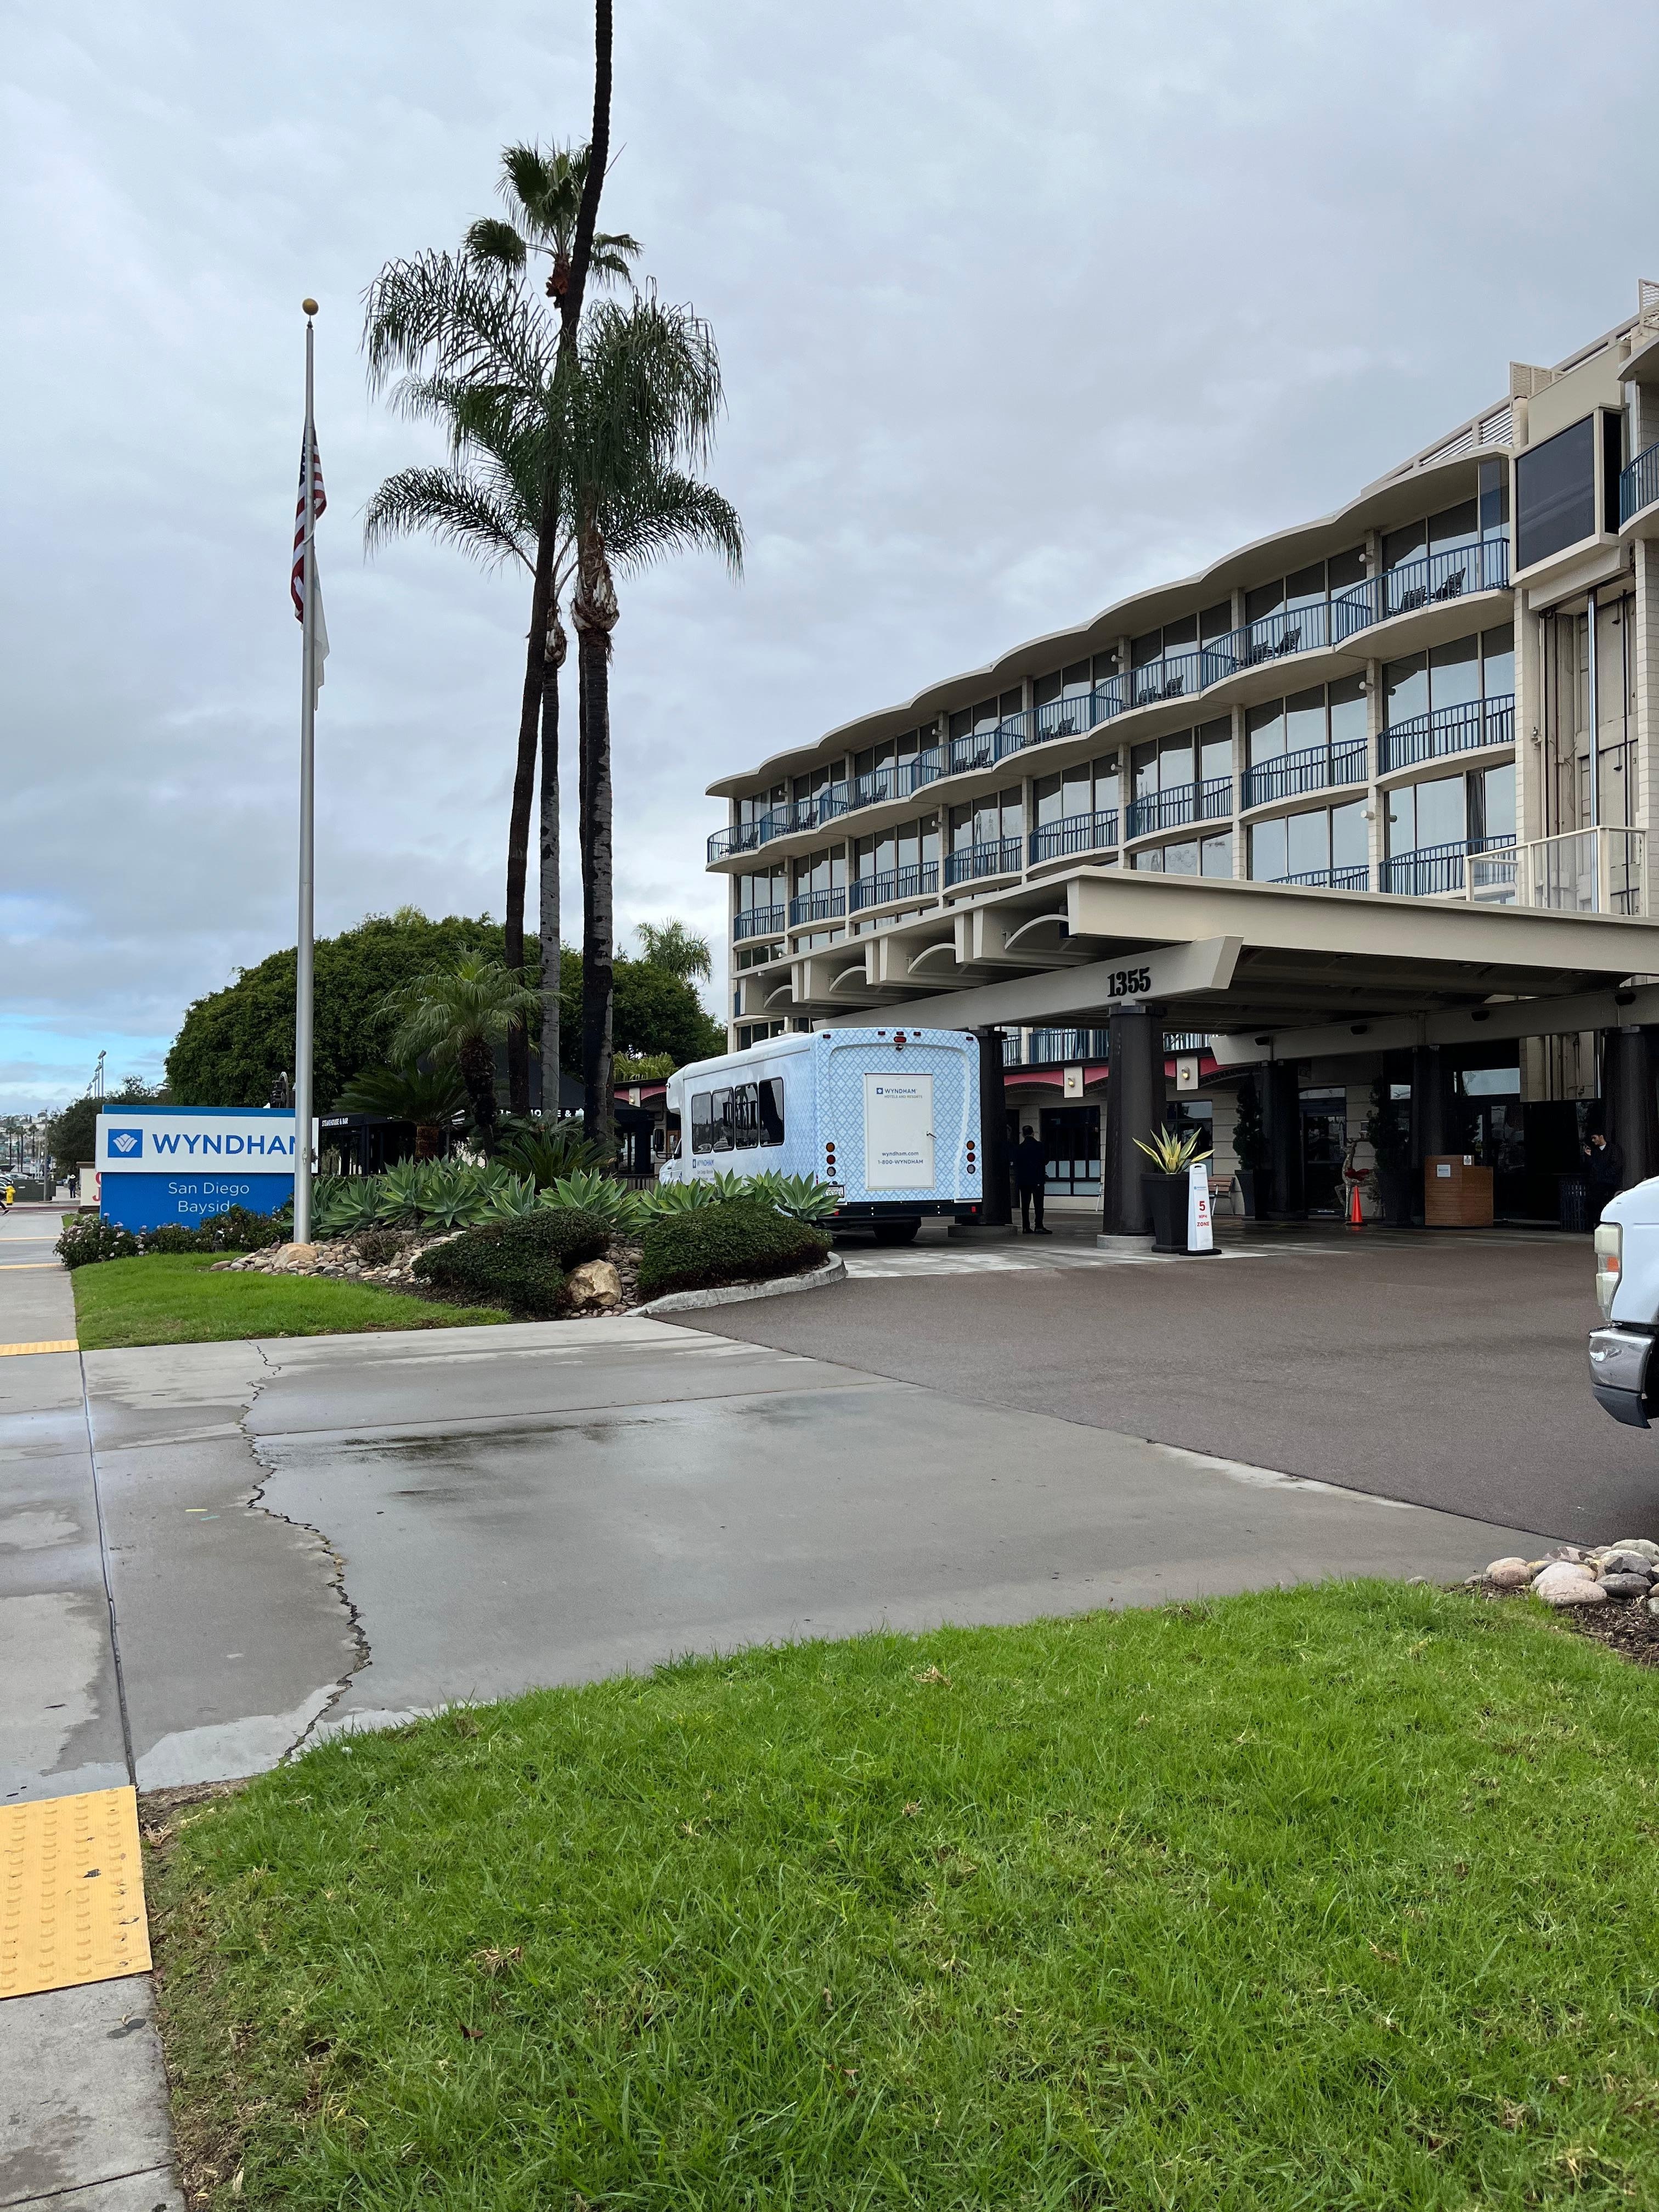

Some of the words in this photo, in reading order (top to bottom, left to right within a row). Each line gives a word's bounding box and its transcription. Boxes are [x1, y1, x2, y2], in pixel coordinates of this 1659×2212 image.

[1107, 967, 1151, 997] 1355
[168, 1182, 197, 1194] San
[204, 1182, 250, 1196] Diego
[1199, 1201, 1205, 1211] 5
